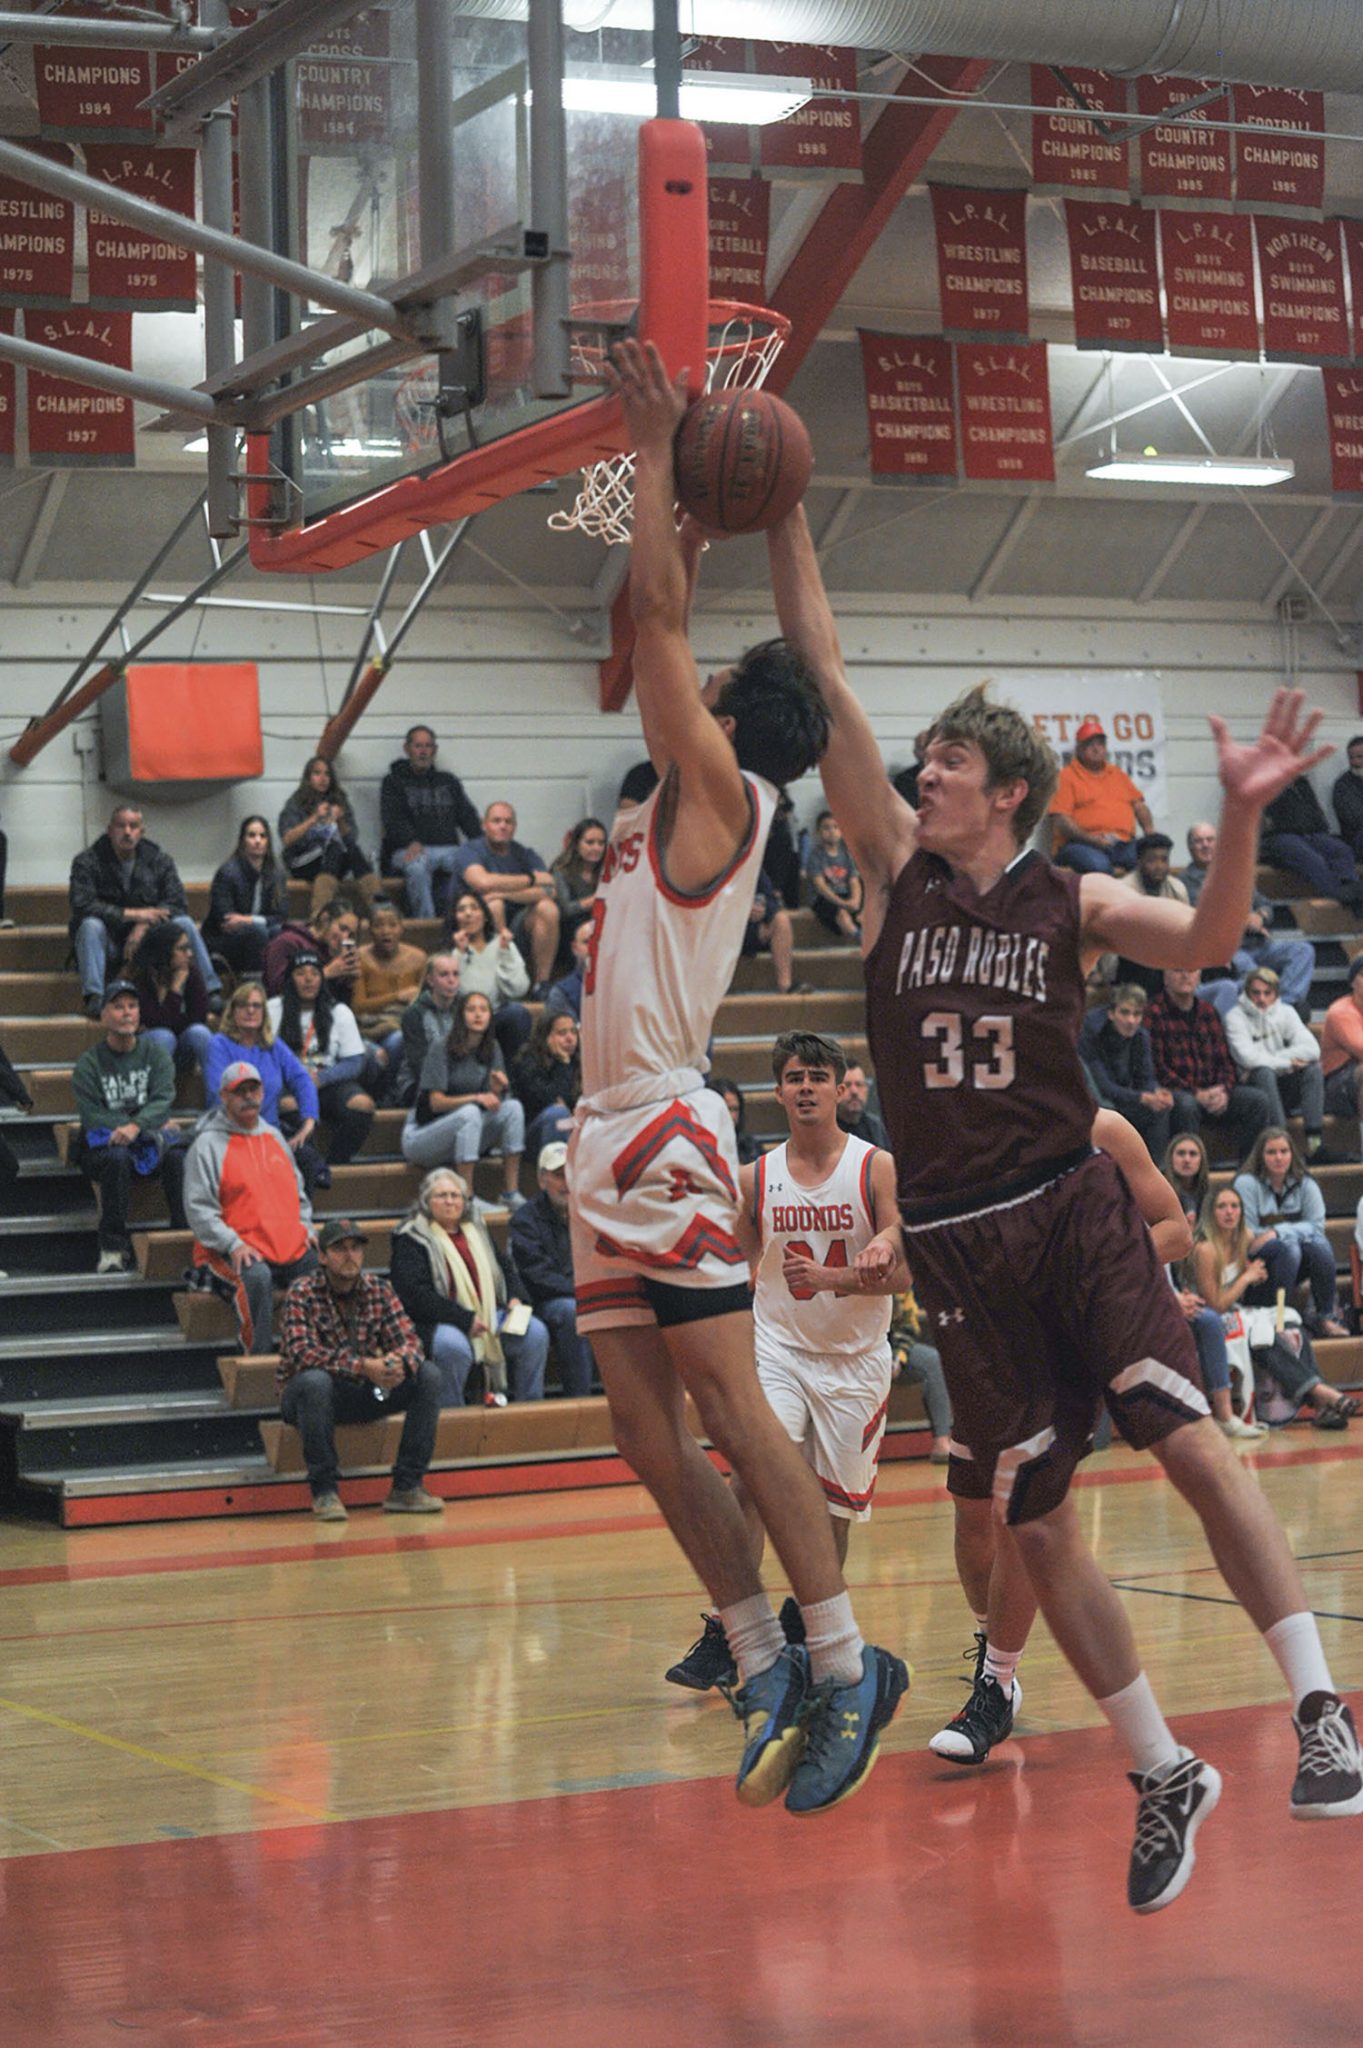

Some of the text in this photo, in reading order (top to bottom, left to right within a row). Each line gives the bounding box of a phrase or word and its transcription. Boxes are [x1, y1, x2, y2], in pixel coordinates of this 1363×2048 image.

[44, 64, 141, 85] CHAMPIONS
[297, 65, 373, 85] COUNTRY
[79, 102, 112, 116] 1984
[1056, 96, 1105, 114] CRSS
[782, 110, 852, 128] AMPIONS
[1050, 115, 1113, 136] COUNTY
[1155, 127, 1217, 147] COUNTRY
[1041, 140, 1123, 162] CHAMPIONS
[1148, 151, 1226, 172] CHAMPIONS
[1243, 146, 1319, 170] CHAMPIONS
[95, 240, 189, 261] CHAMPIONS
[942, 243, 1022, 264] WRESTLING
[1264, 232, 1336, 264] NORTHERN
[1080, 254, 1148, 274] BASEBALL
[3, 268, 34, 282] 1975
[127, 274, 158, 287] 1975
[945, 274, 1024, 296] CHAMPIONS
[1269, 273, 1336, 295] SWIMMING
[1079, 285, 1155, 305] CHAMPIONS
[1172, 295, 1250, 316] CHAMPIONS
[1269, 301, 1341, 323] CHAMPIONS
[36, 394, 126, 414] CHAMPIONS
[868, 393, 952, 413] BASKETBALL
[965, 395, 1044, 414] WRESTLING
[875, 422, 951, 441] CHAMPIONS
[969, 425, 1046, 445] CHAMPIONS
[1112, 713, 1155, 742] GO
[895, 925, 1050, 1003] PASO ROBLES
[921, 1011, 1016, 1090] 33
[772, 1203, 855, 1233] HOUNDS
